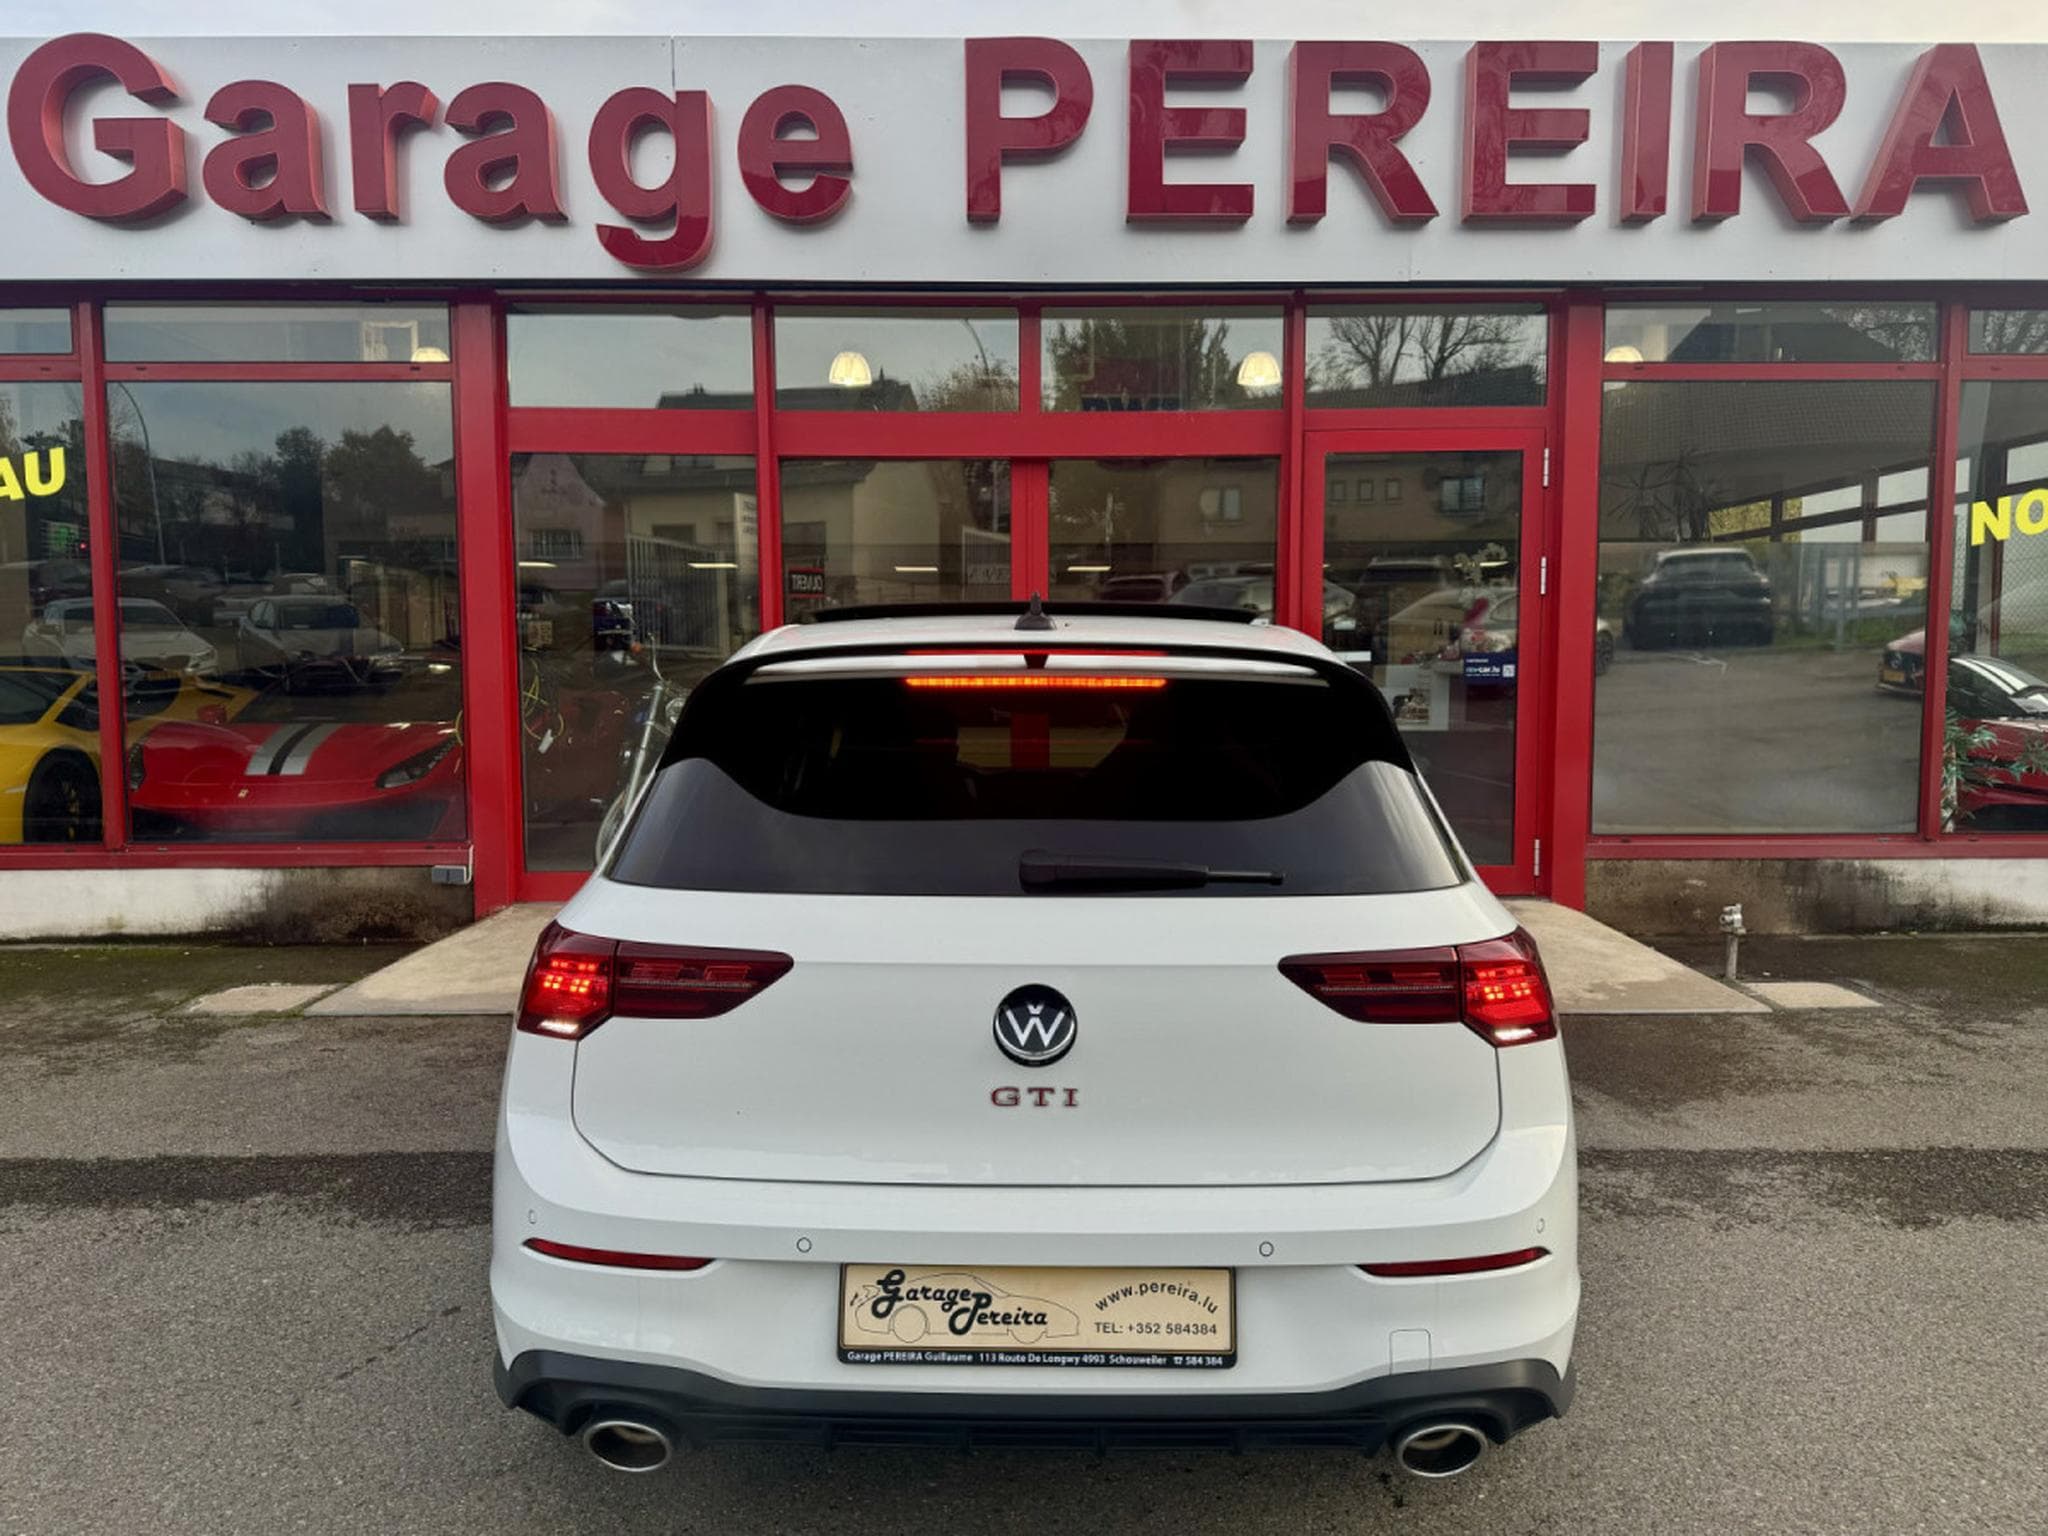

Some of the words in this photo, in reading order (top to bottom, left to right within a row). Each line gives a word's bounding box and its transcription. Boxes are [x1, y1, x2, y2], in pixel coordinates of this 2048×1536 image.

[7, 32, 854, 273] Garage
[964, 36, 2030, 226] PEREIRA
[991, 1086, 1079, 1107] GTI
[871, 1269, 973, 1319] Garage
[1095, 1281, 1218, 1314] www.pereira.lu
[949, 1292, 1048, 1335] Pereira
[1095, 1321, 1123, 1334] TEL:
[1128, 1322, 1160, 1334] +352
[1166, 1323, 1217, 1335] 584384
[847, 1351, 882, 1363] Garage
[884, 1351, 923, 1361] PEREIRA
[925, 1352, 973, 1362] Guillaume
[979, 1353, 996, 1363] 113
[999, 1353, 1026, 1363] Route
[1028, 1353, 1041, 1363] De
[1043, 1353, 1080, 1365] Longwy
[1185, 1356, 1203, 1365] 584
